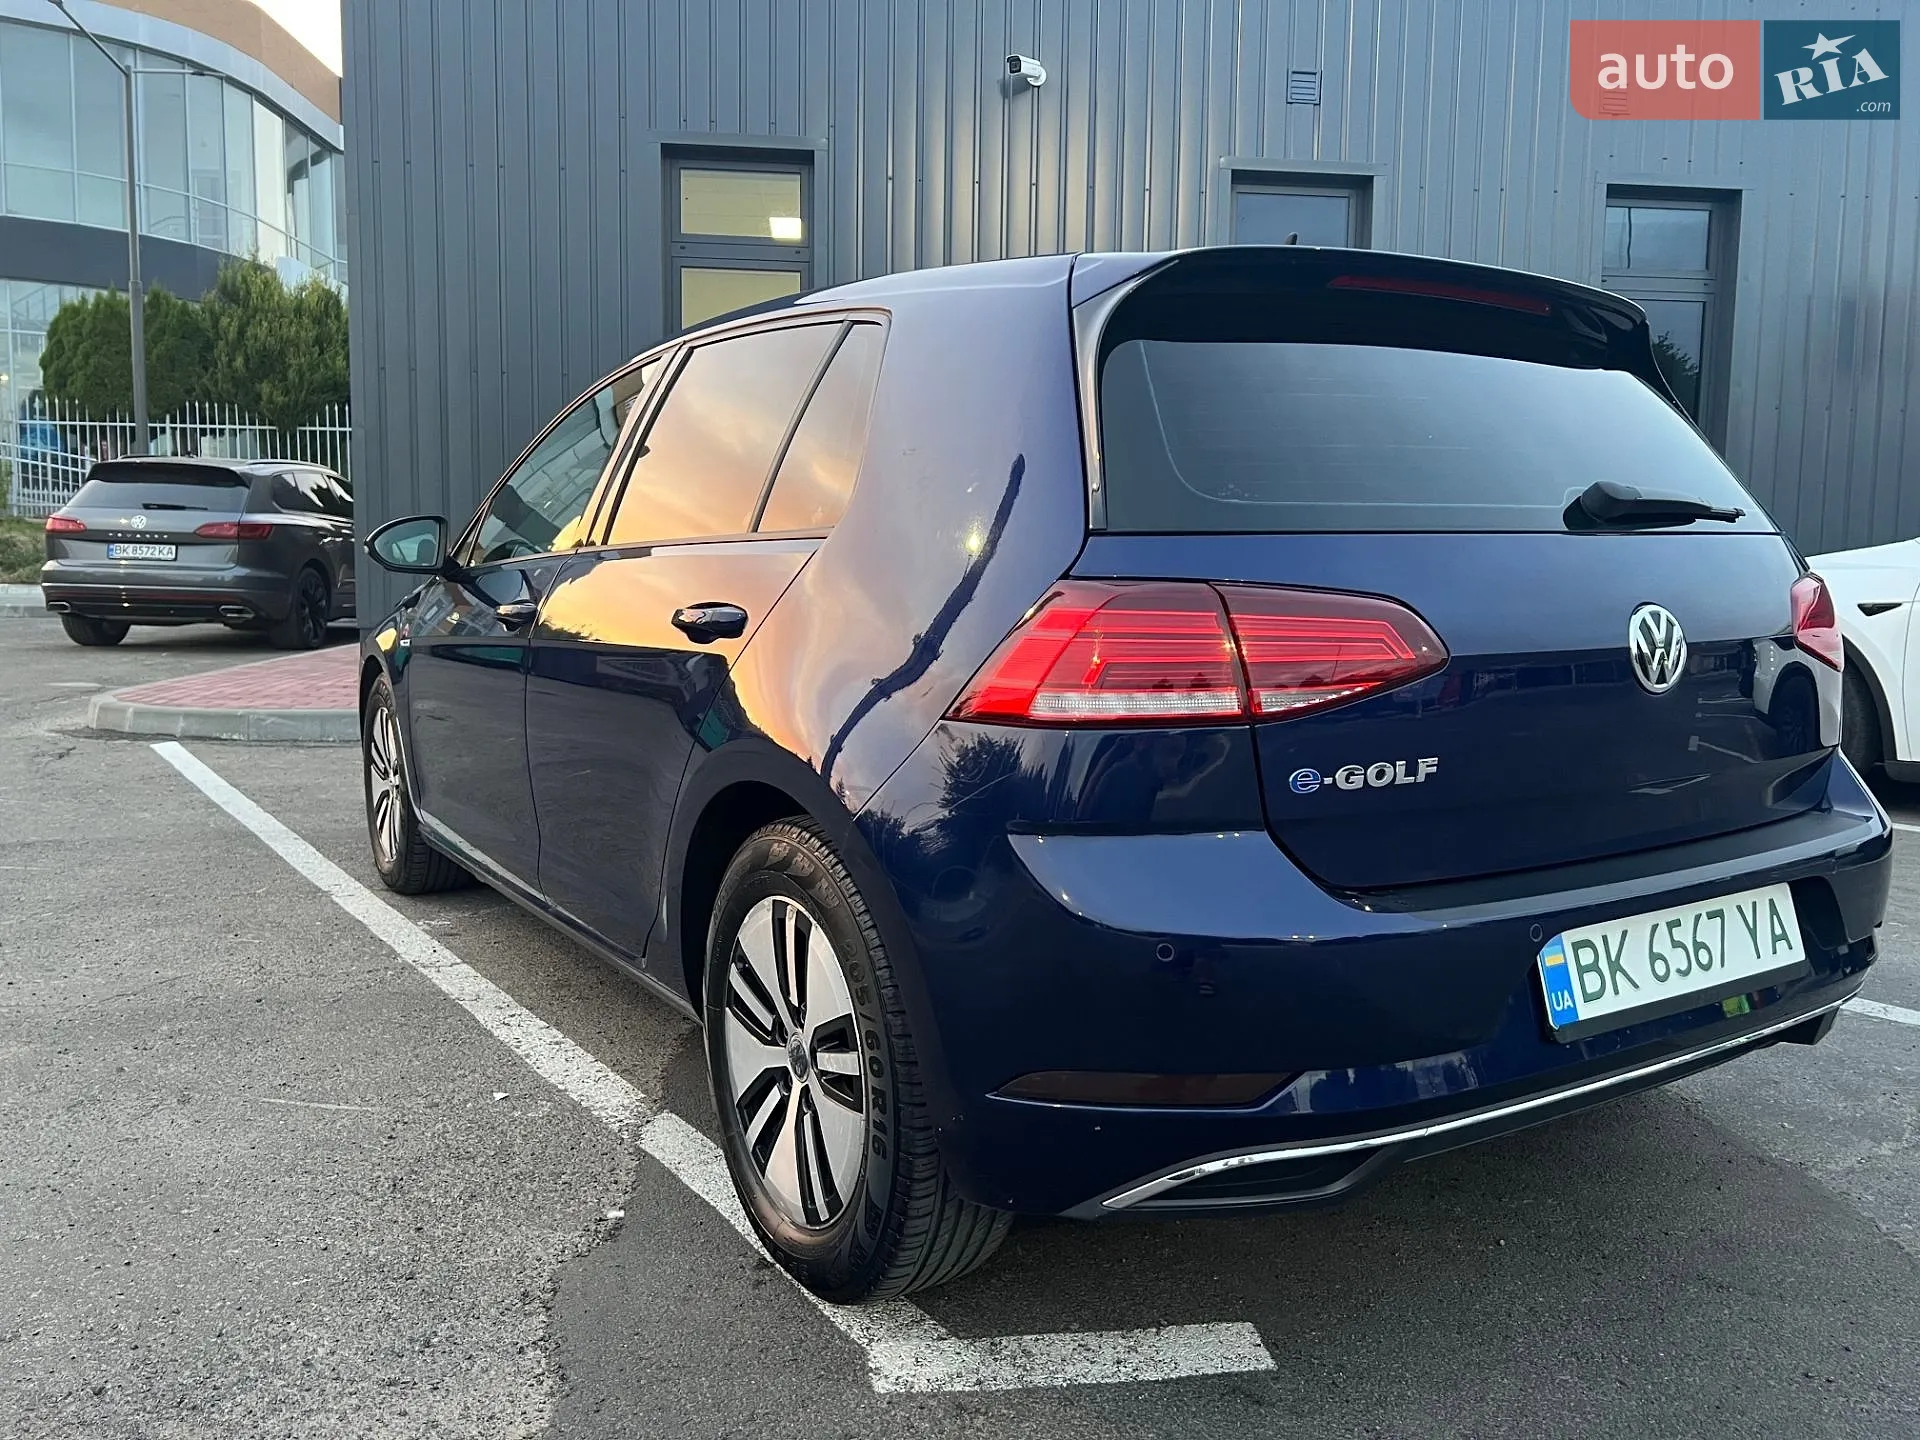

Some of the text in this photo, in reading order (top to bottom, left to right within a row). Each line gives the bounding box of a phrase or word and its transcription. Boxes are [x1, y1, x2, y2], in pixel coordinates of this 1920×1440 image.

[114, 544, 174, 557] BK 8572 KA
[1288, 757, 1439, 794] e-GOLF
[1571, 897, 1794, 1004] BK 6567 YA
[1551, 990, 1574, 1012] UA
